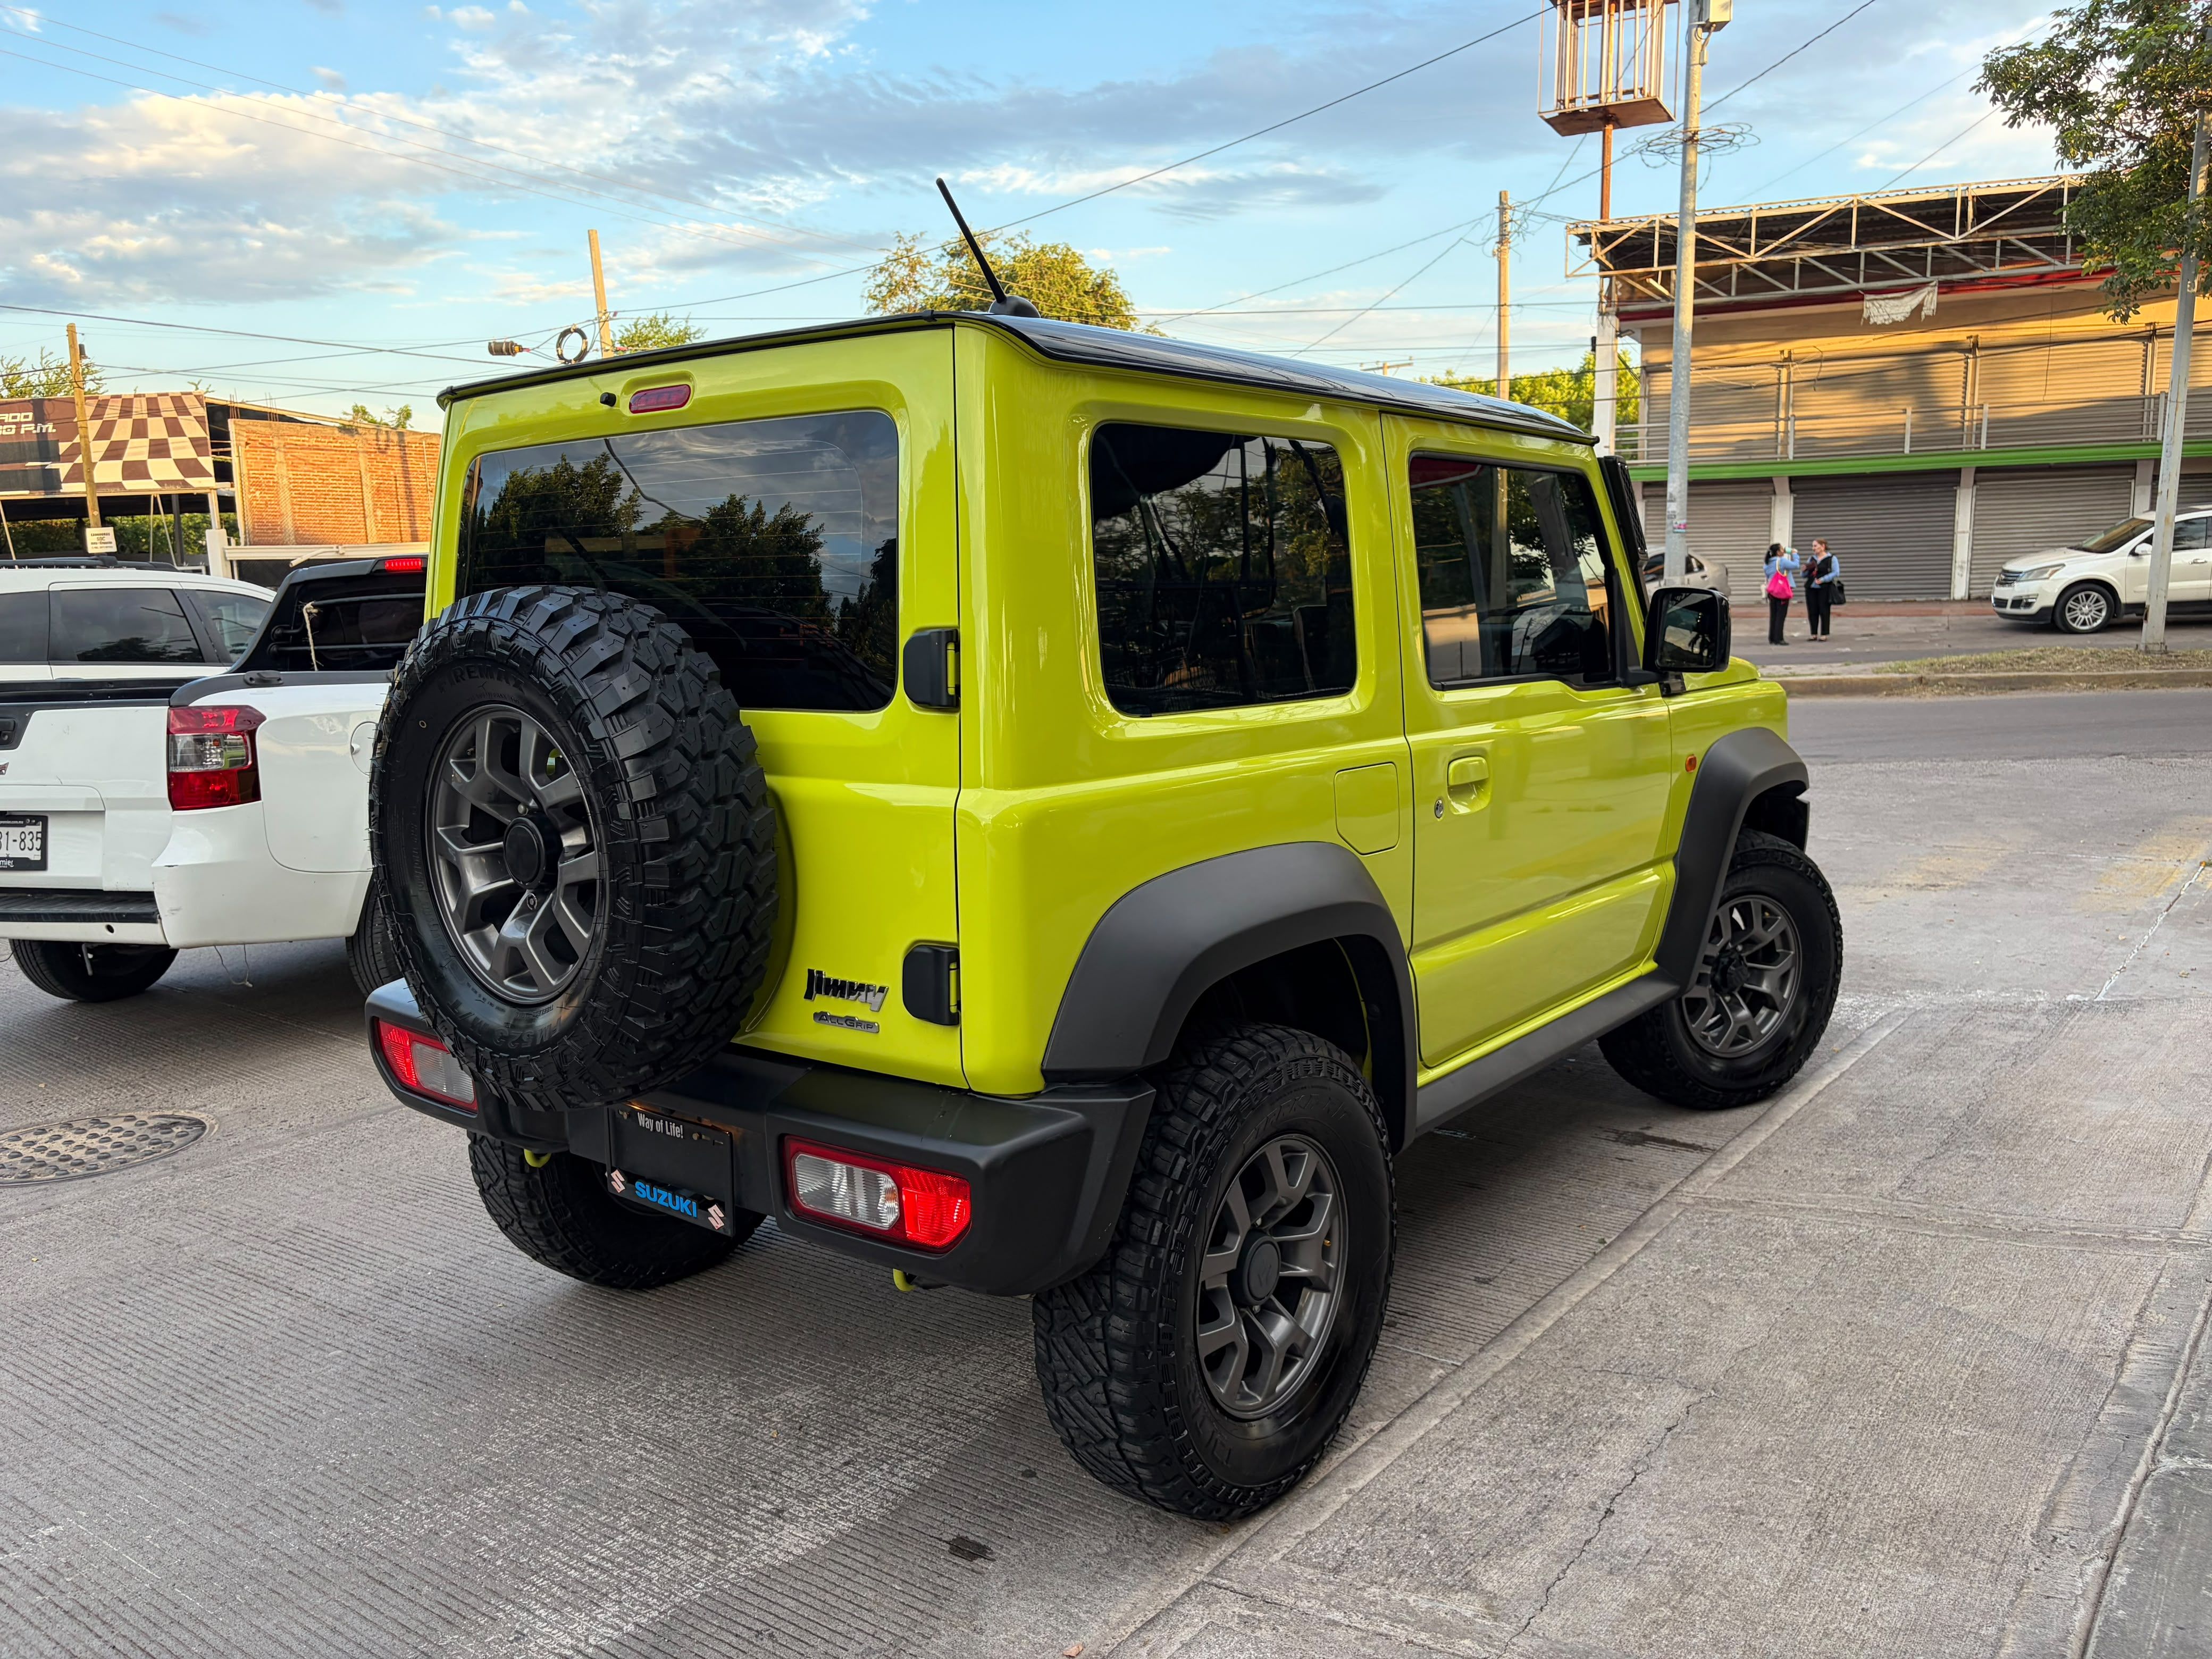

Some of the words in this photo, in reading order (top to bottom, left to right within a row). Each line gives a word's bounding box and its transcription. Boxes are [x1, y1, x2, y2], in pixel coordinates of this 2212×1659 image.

[637, 1112, 653, 1132] Way
[655, 1119, 664, 1134] of
[665, 1121, 684, 1138] Life!
[635, 1181, 698, 1218] SUZUKI
